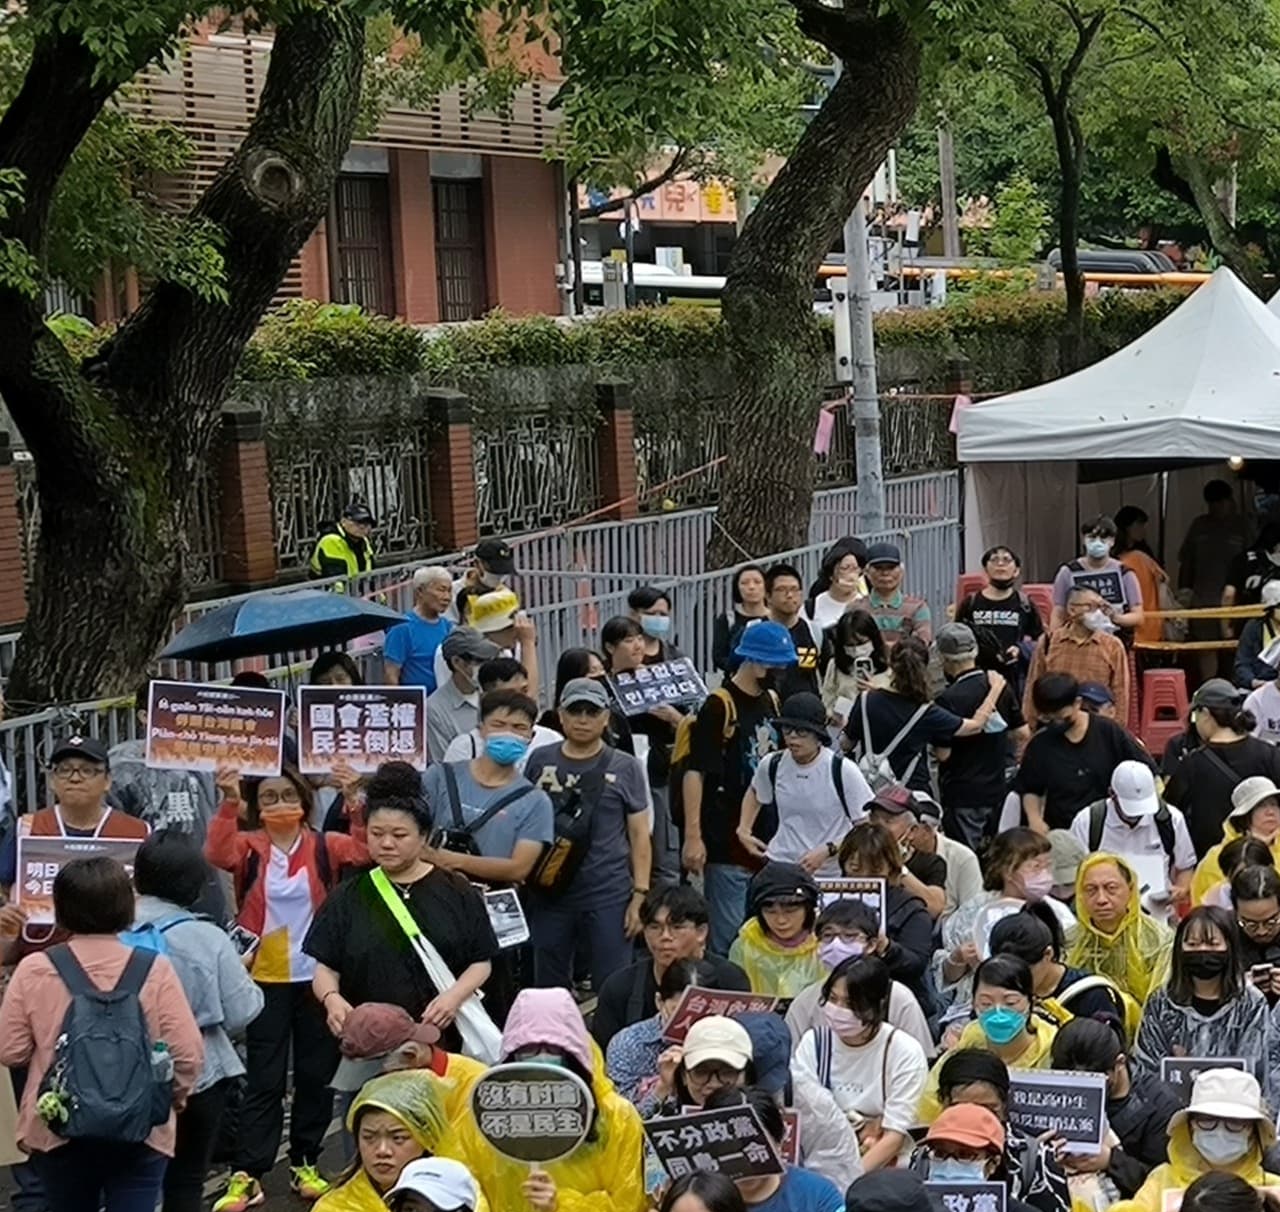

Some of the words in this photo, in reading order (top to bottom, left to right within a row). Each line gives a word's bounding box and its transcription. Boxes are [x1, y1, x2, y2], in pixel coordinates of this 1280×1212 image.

[625, 680, 699, 706] 민주없다
[310, 704, 417, 729] 國會濫權
[312, 730, 416, 754] 民主倒退
[480, 1082, 578, 1108] 沒有討論
[483, 1111, 582, 1138] 不是民主
[652, 1116, 758, 1152] 不分政黨
